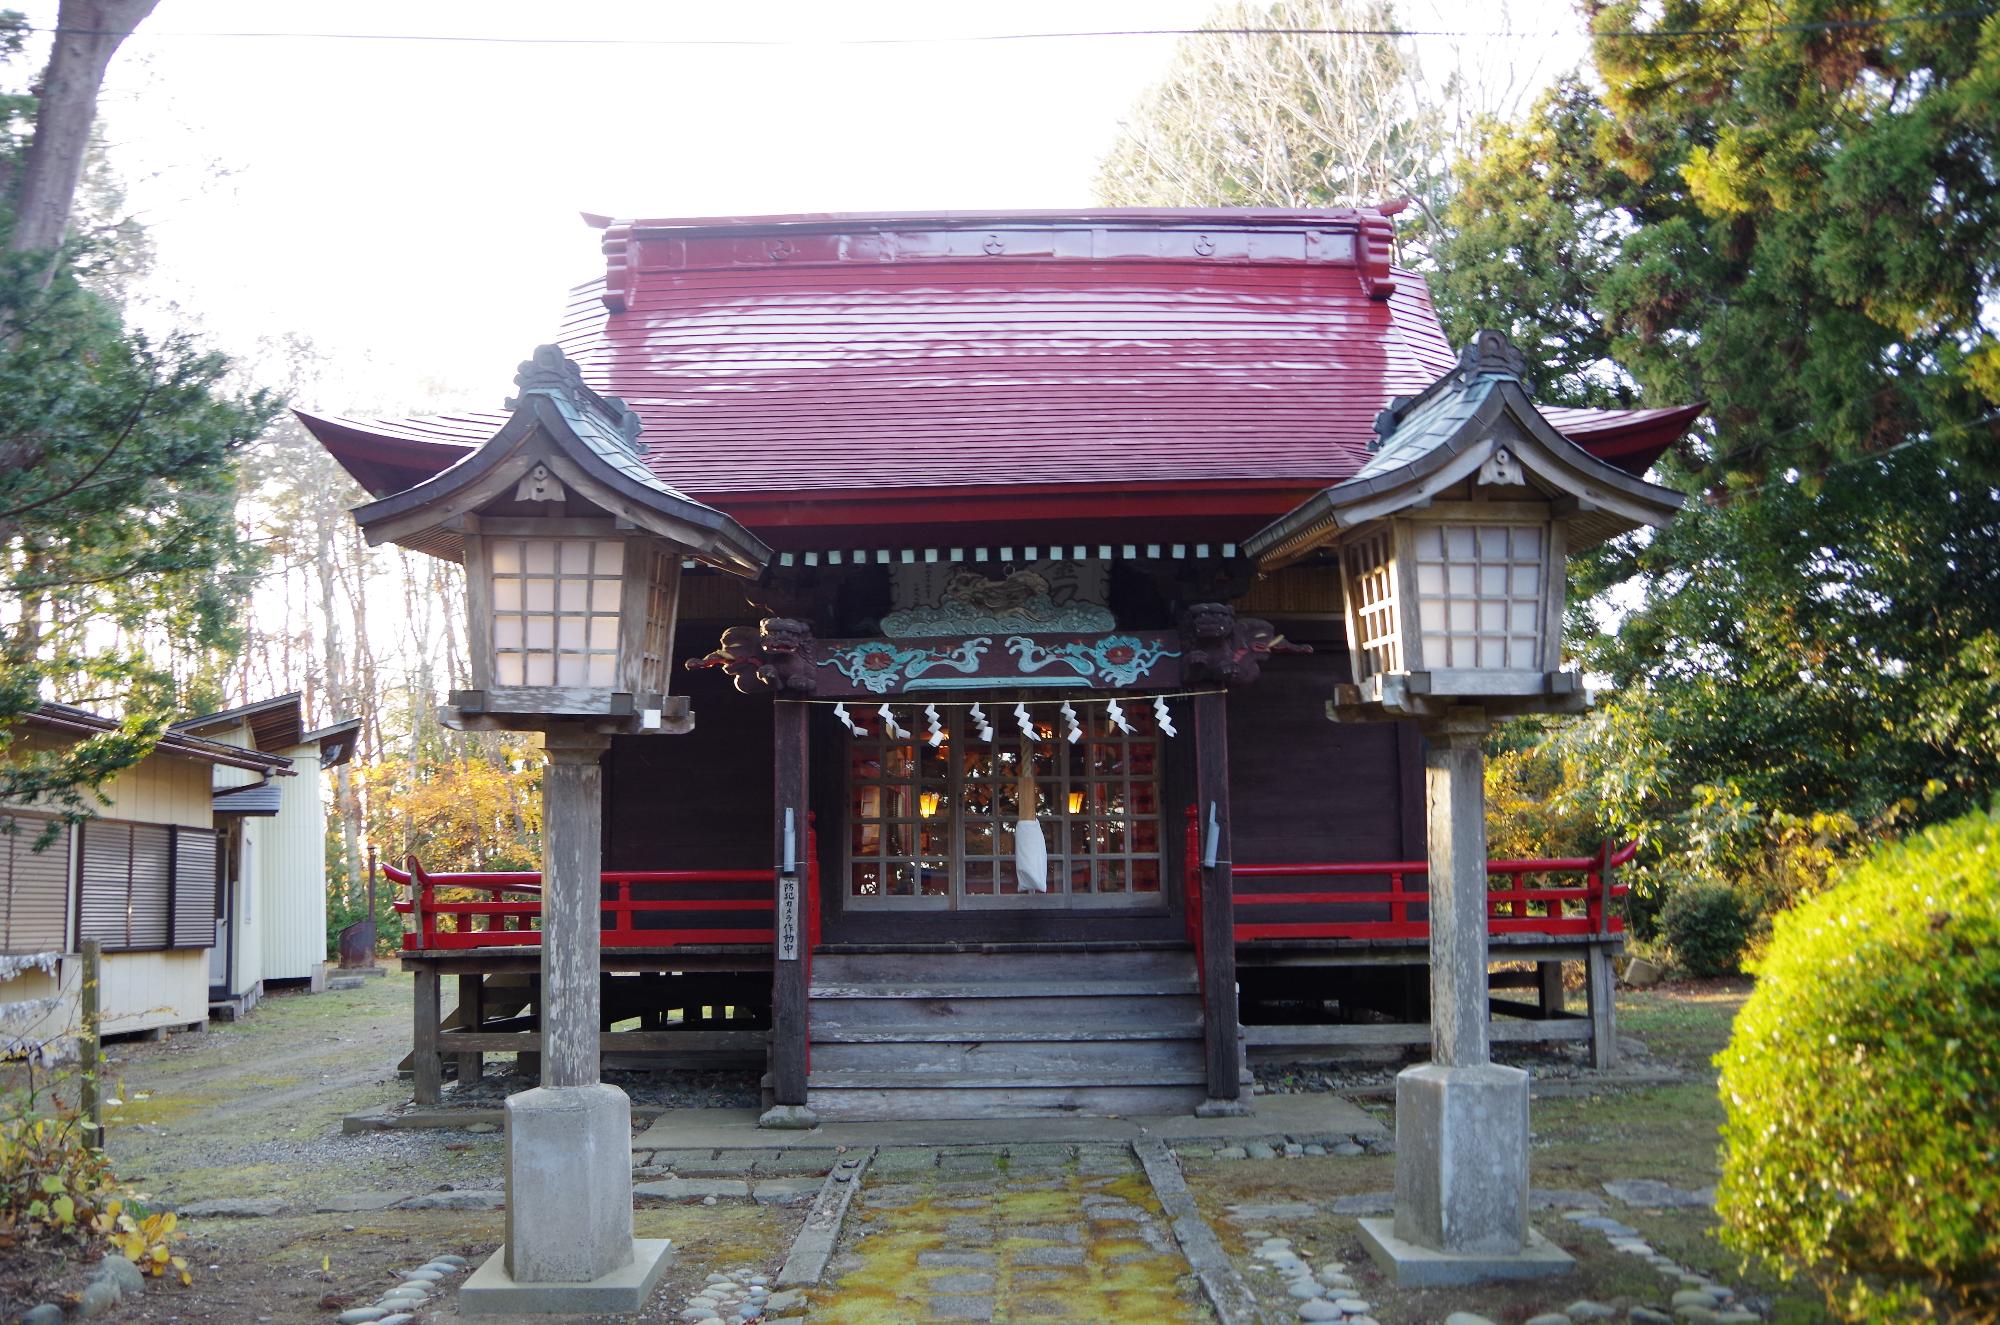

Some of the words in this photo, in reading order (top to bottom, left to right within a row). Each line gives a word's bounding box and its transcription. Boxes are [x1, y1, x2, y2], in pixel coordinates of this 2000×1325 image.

[783, 883, 795, 958] 防犯カメラ作動中
